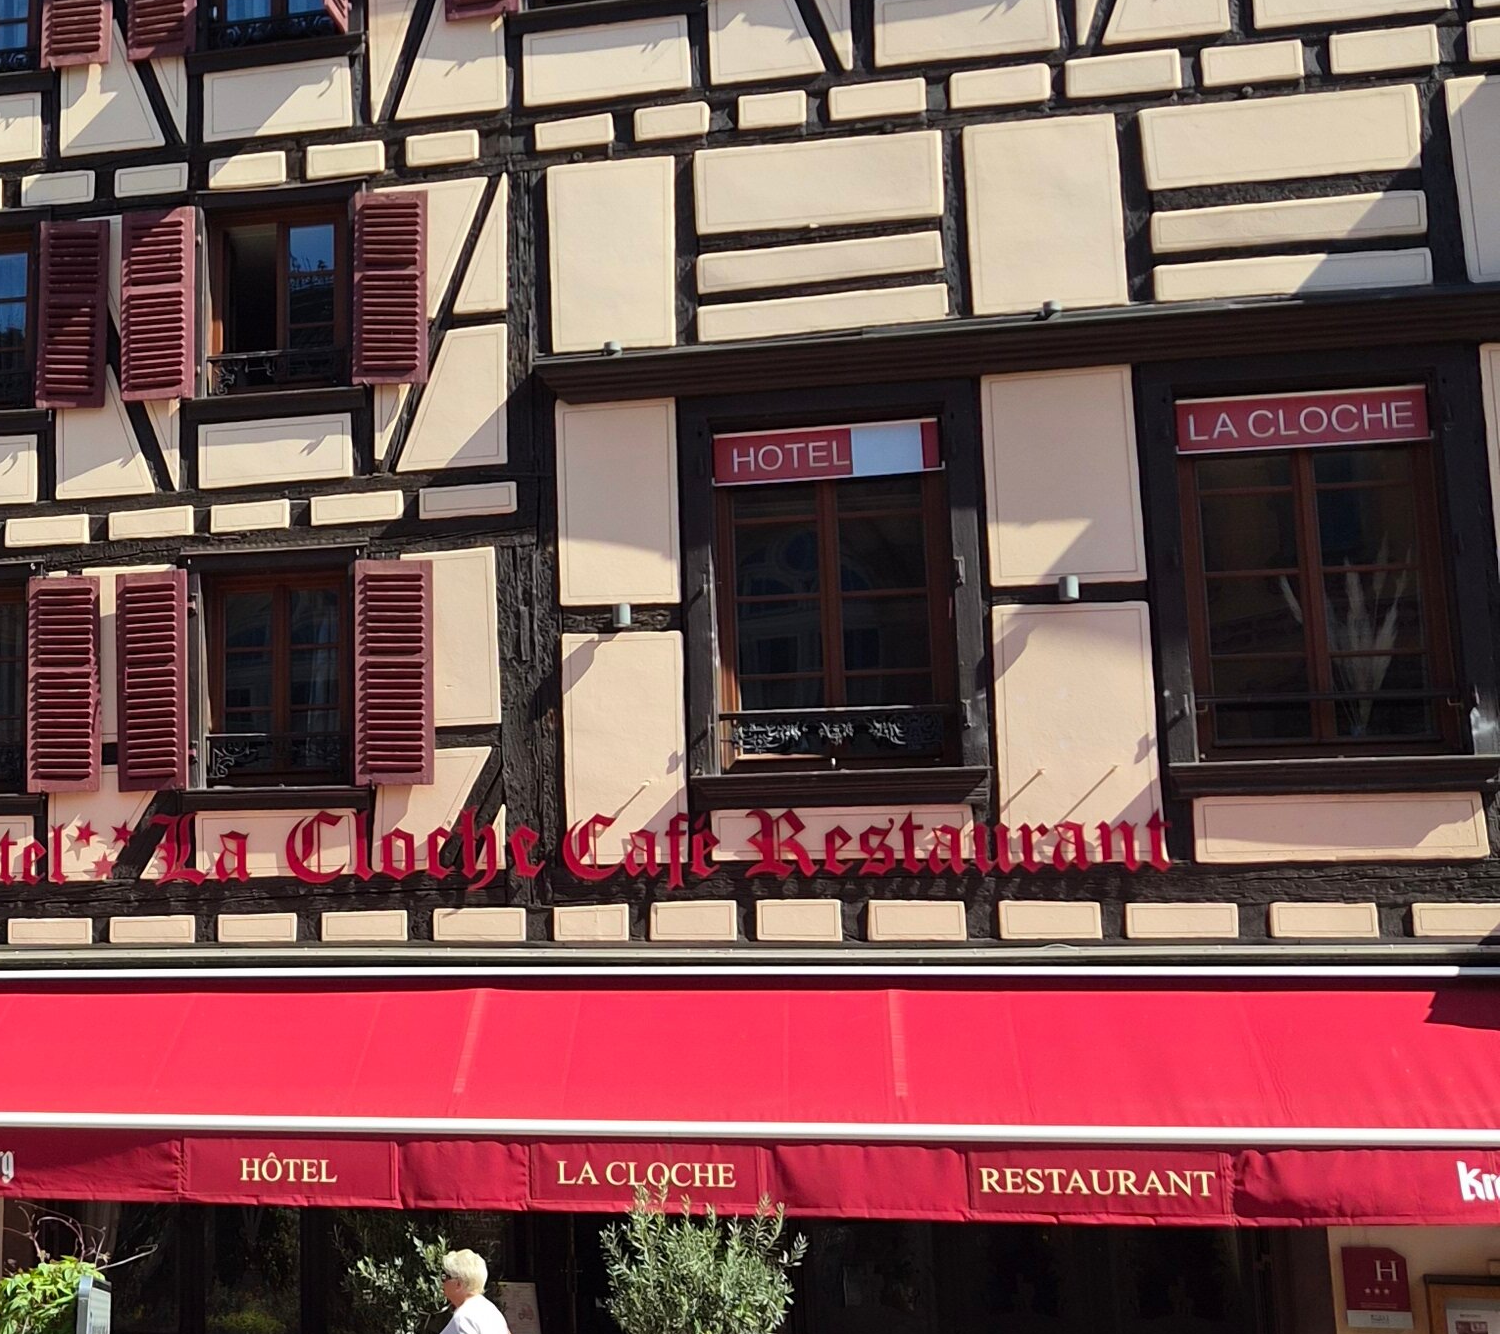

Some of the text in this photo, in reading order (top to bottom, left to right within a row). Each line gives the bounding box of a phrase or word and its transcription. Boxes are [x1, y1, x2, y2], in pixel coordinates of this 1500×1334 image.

[1187, 400, 1416, 442] LA CLOCHE
[732, 440, 851, 474] HOTEL
[151, 812, 253, 887] La
[285, 805, 546, 892] Cloche
[745, 808, 1174, 881] Restaurant
[240, 1151, 338, 1184] HÔTEL
[556, 1160, 737, 1188] LA CLOCHE
[979, 1166, 1217, 1198] RESTAURANT
[1374, 1259, 1398, 1282] H
